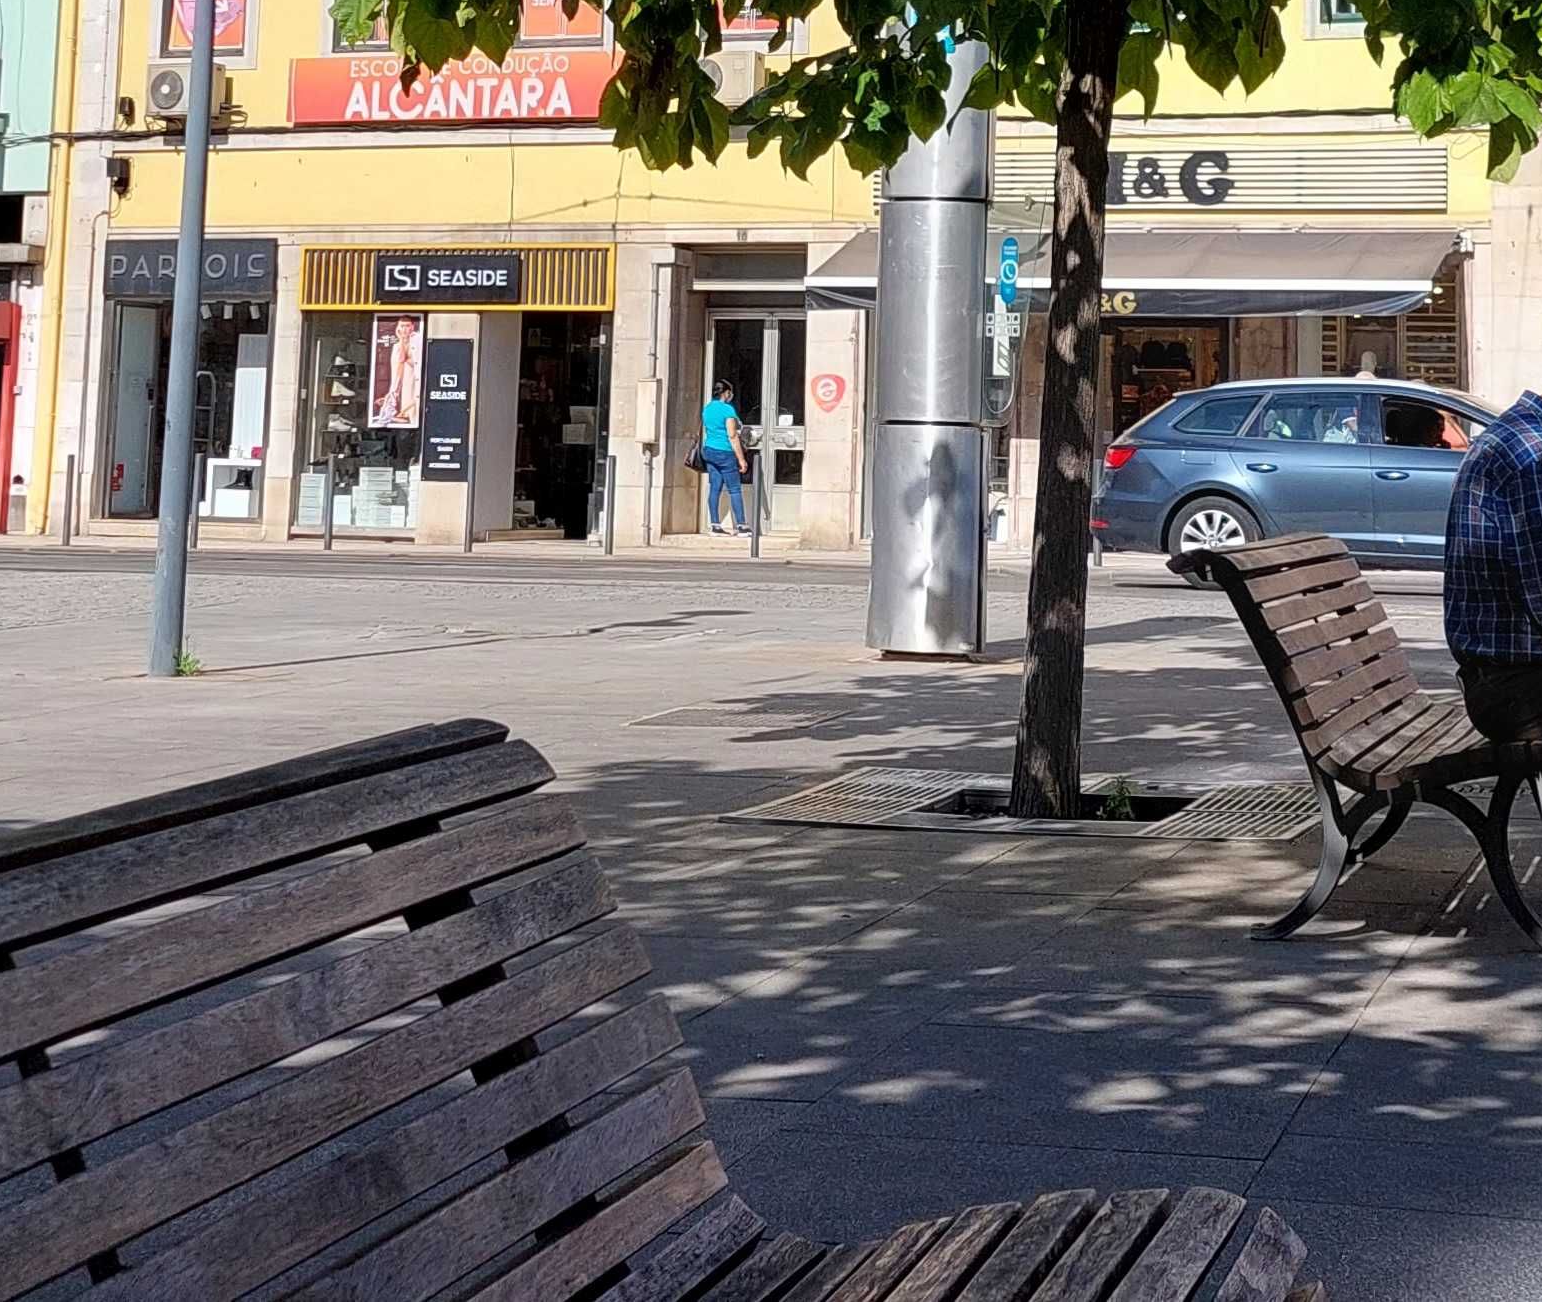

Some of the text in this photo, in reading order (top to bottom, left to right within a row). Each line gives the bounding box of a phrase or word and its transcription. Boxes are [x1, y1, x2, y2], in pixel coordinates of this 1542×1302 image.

[459, 53, 569, 78] CONDUÇÃO
[344, 75, 572, 120] ALCÂNTARA
[110, 253, 266, 279] PAROIS
[428, 270, 508, 286] SEASIDE
[430, 390, 467, 400] SEASIDE
